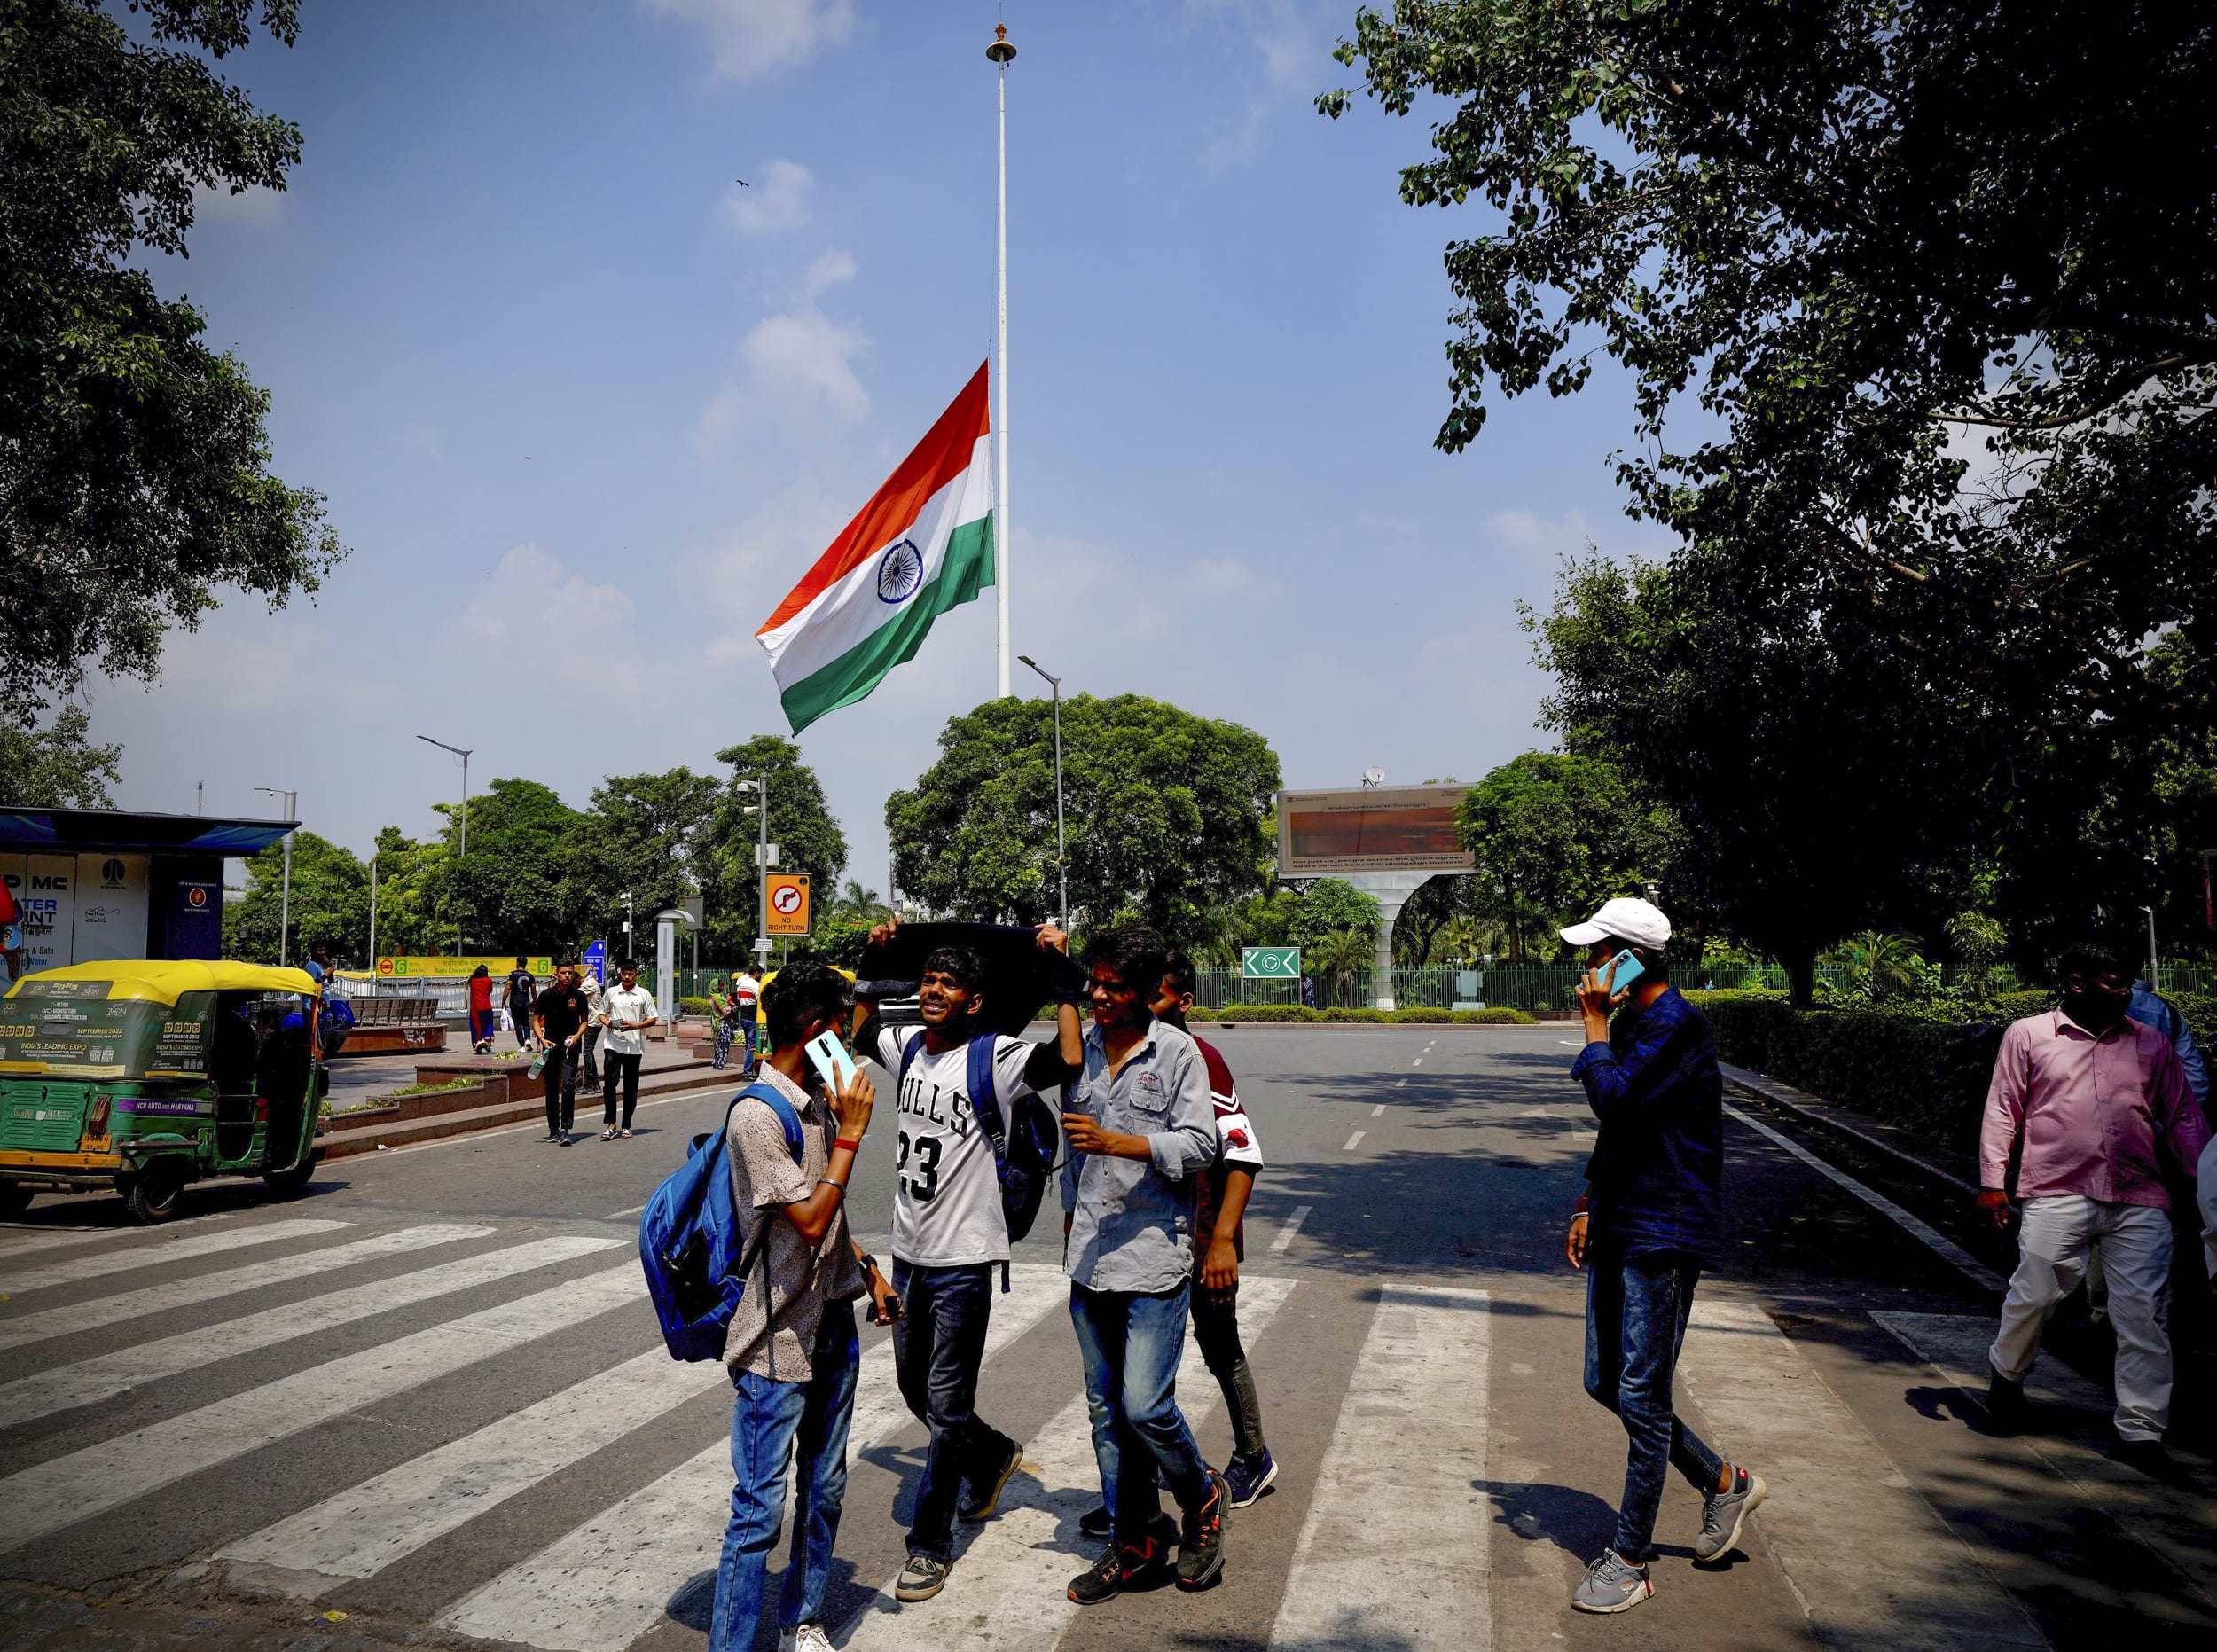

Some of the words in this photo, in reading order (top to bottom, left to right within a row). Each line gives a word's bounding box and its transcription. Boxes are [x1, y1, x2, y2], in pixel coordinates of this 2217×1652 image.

[21, 898, 57, 911] TER
[25, 911, 57, 923] INT
[898, 1078, 971, 1139] ULLS
[897, 1130, 943, 1202] 23
